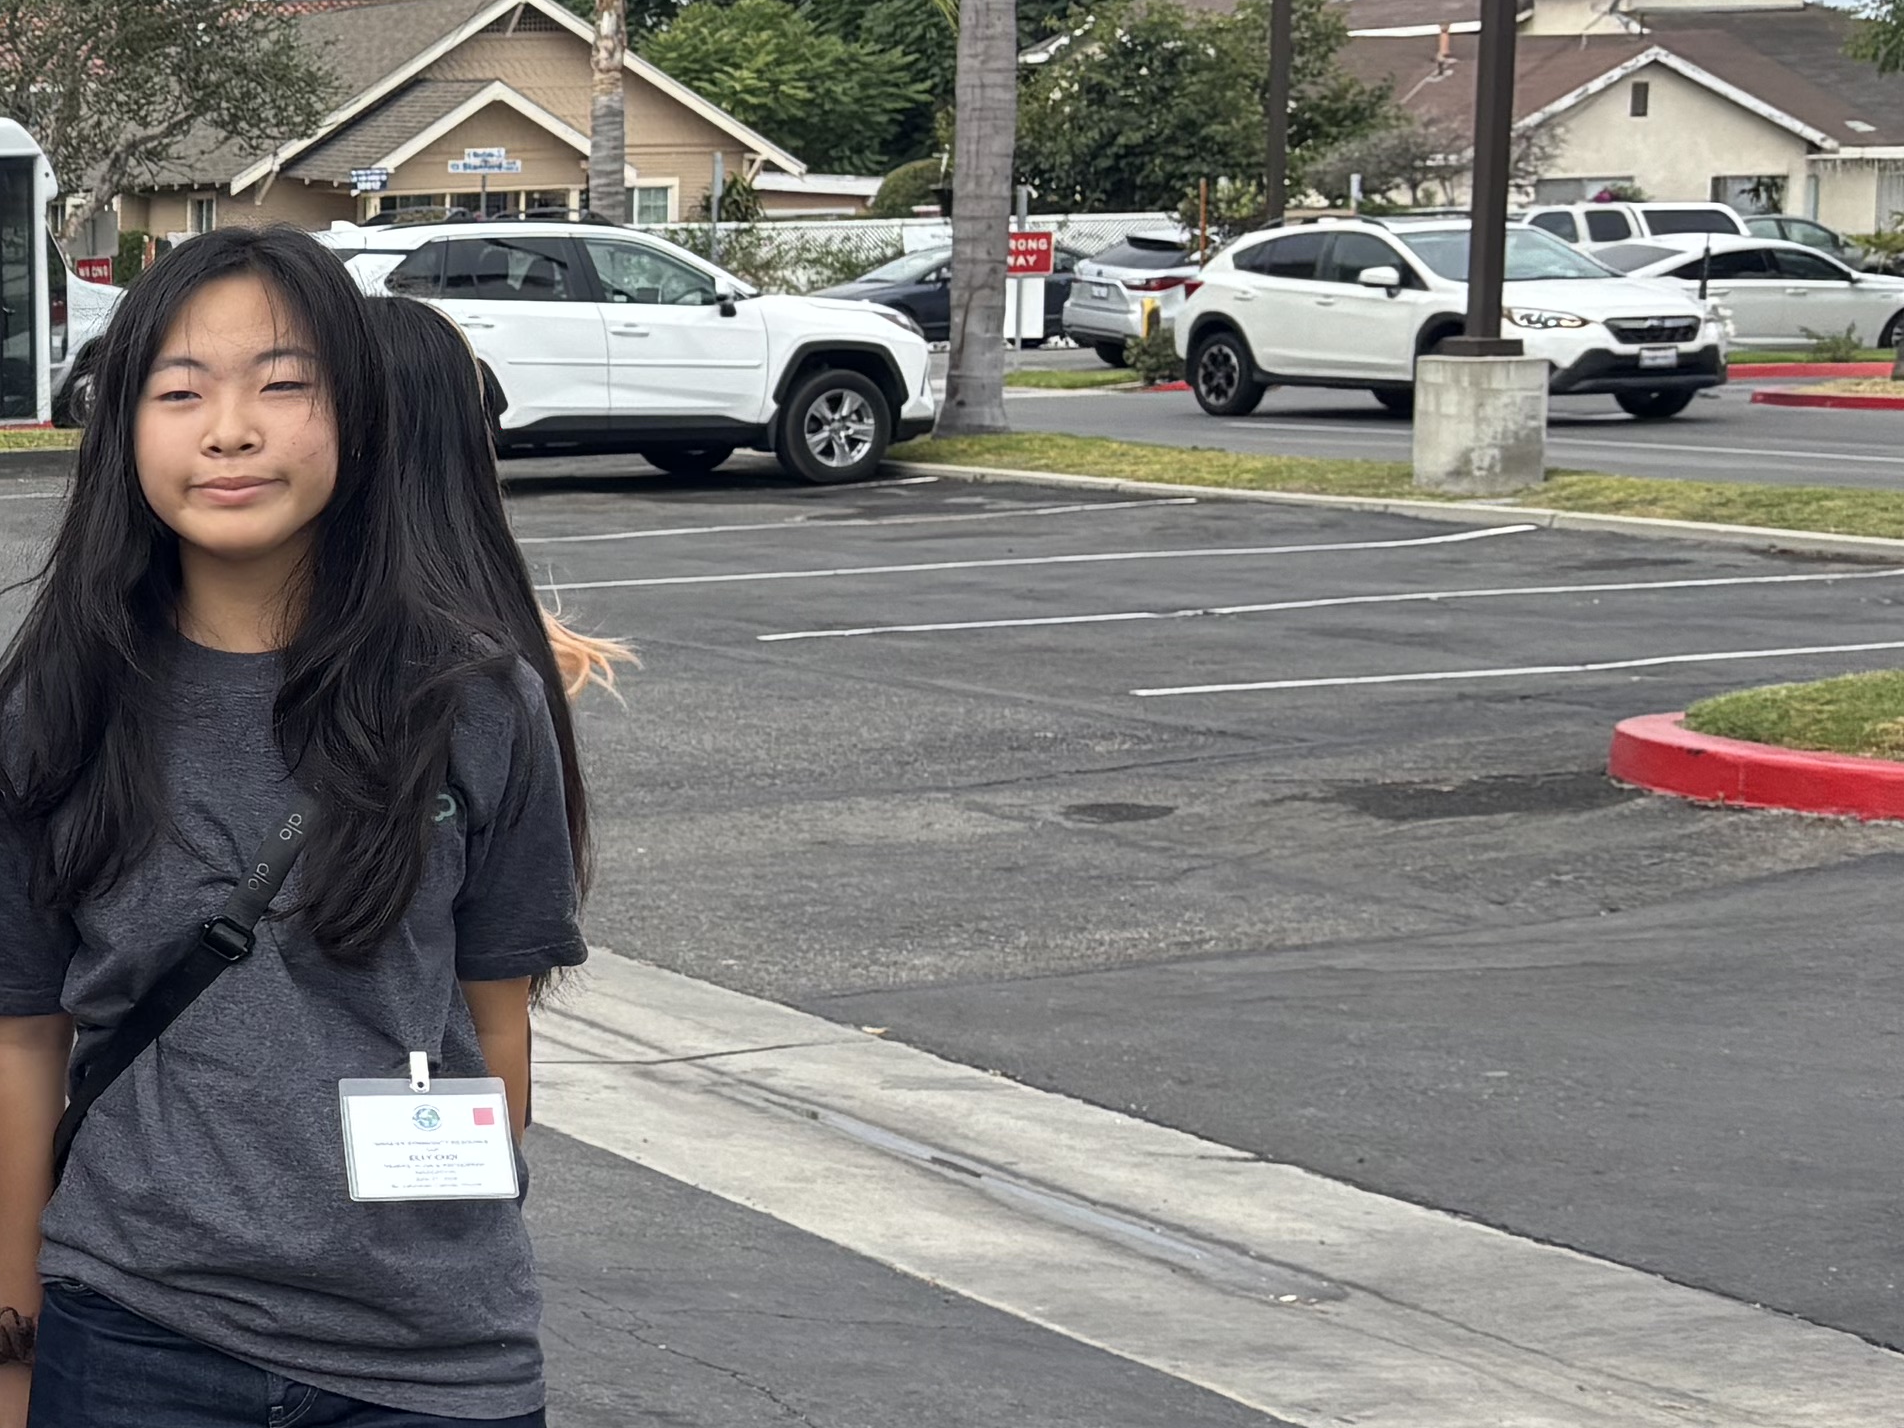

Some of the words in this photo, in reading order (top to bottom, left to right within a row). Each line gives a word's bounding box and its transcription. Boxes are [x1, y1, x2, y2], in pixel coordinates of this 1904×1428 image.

[1009, 238, 1048, 251] RONG
[279, 813, 304, 841] alo
[248, 863, 271, 891] alo
